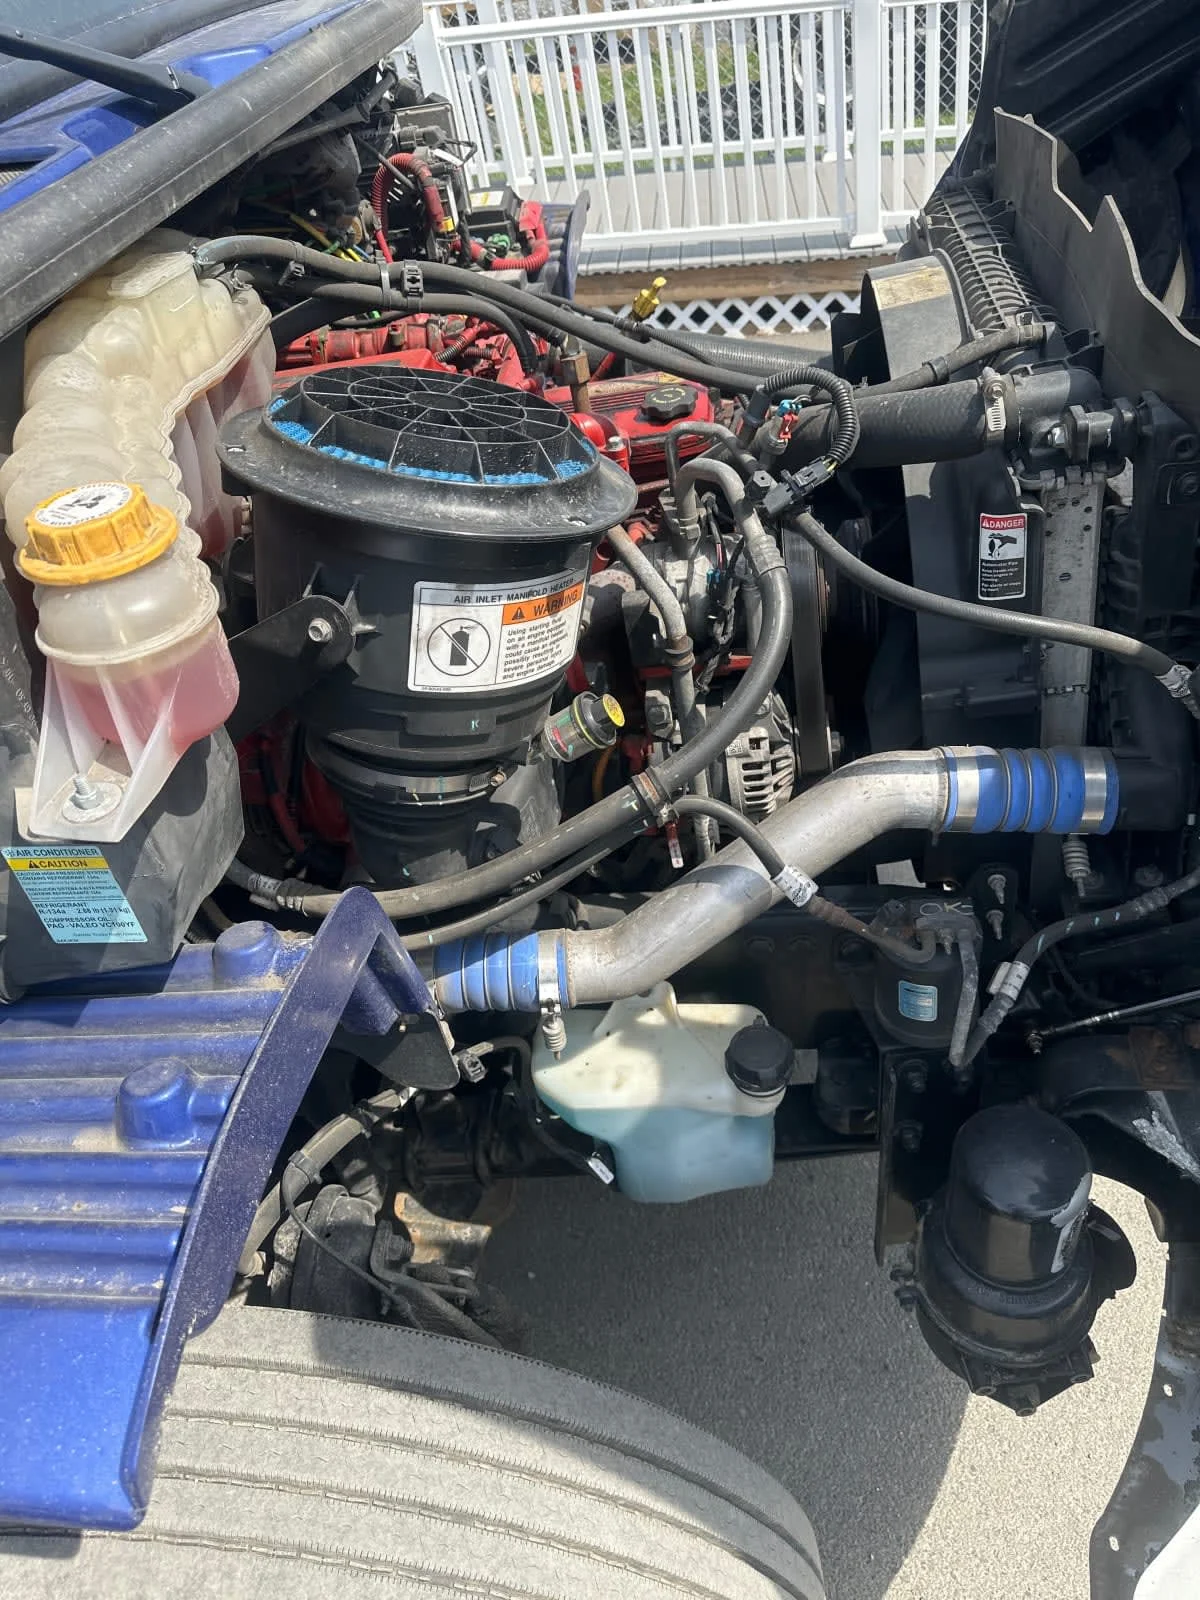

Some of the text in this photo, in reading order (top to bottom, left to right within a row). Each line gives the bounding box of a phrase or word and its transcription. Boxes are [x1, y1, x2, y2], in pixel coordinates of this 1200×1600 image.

[990, 519, 1024, 529] DANGER
[454, 595, 471, 604] AIR
[476, 595, 503, 604] INLET
[506, 588, 548, 601] MANIFOLD
[533, 589, 578, 617] WARNING
[508, 628, 526, 636] Using
[529, 622, 550, 632] starting
[527, 631, 545, 642] engine
[505, 650, 522, 659] could
[524, 646, 540, 655] cause
[506, 643, 520, 651] with
[504, 655, 530, 666] possibly
[502, 671, 514, 680] and
[516, 667, 535, 678] engine
[504, 664, 524, 673] severe
[15, 848, 99, 857] AIR CONDITIONER
[39, 860, 88, 868] CAUTION
